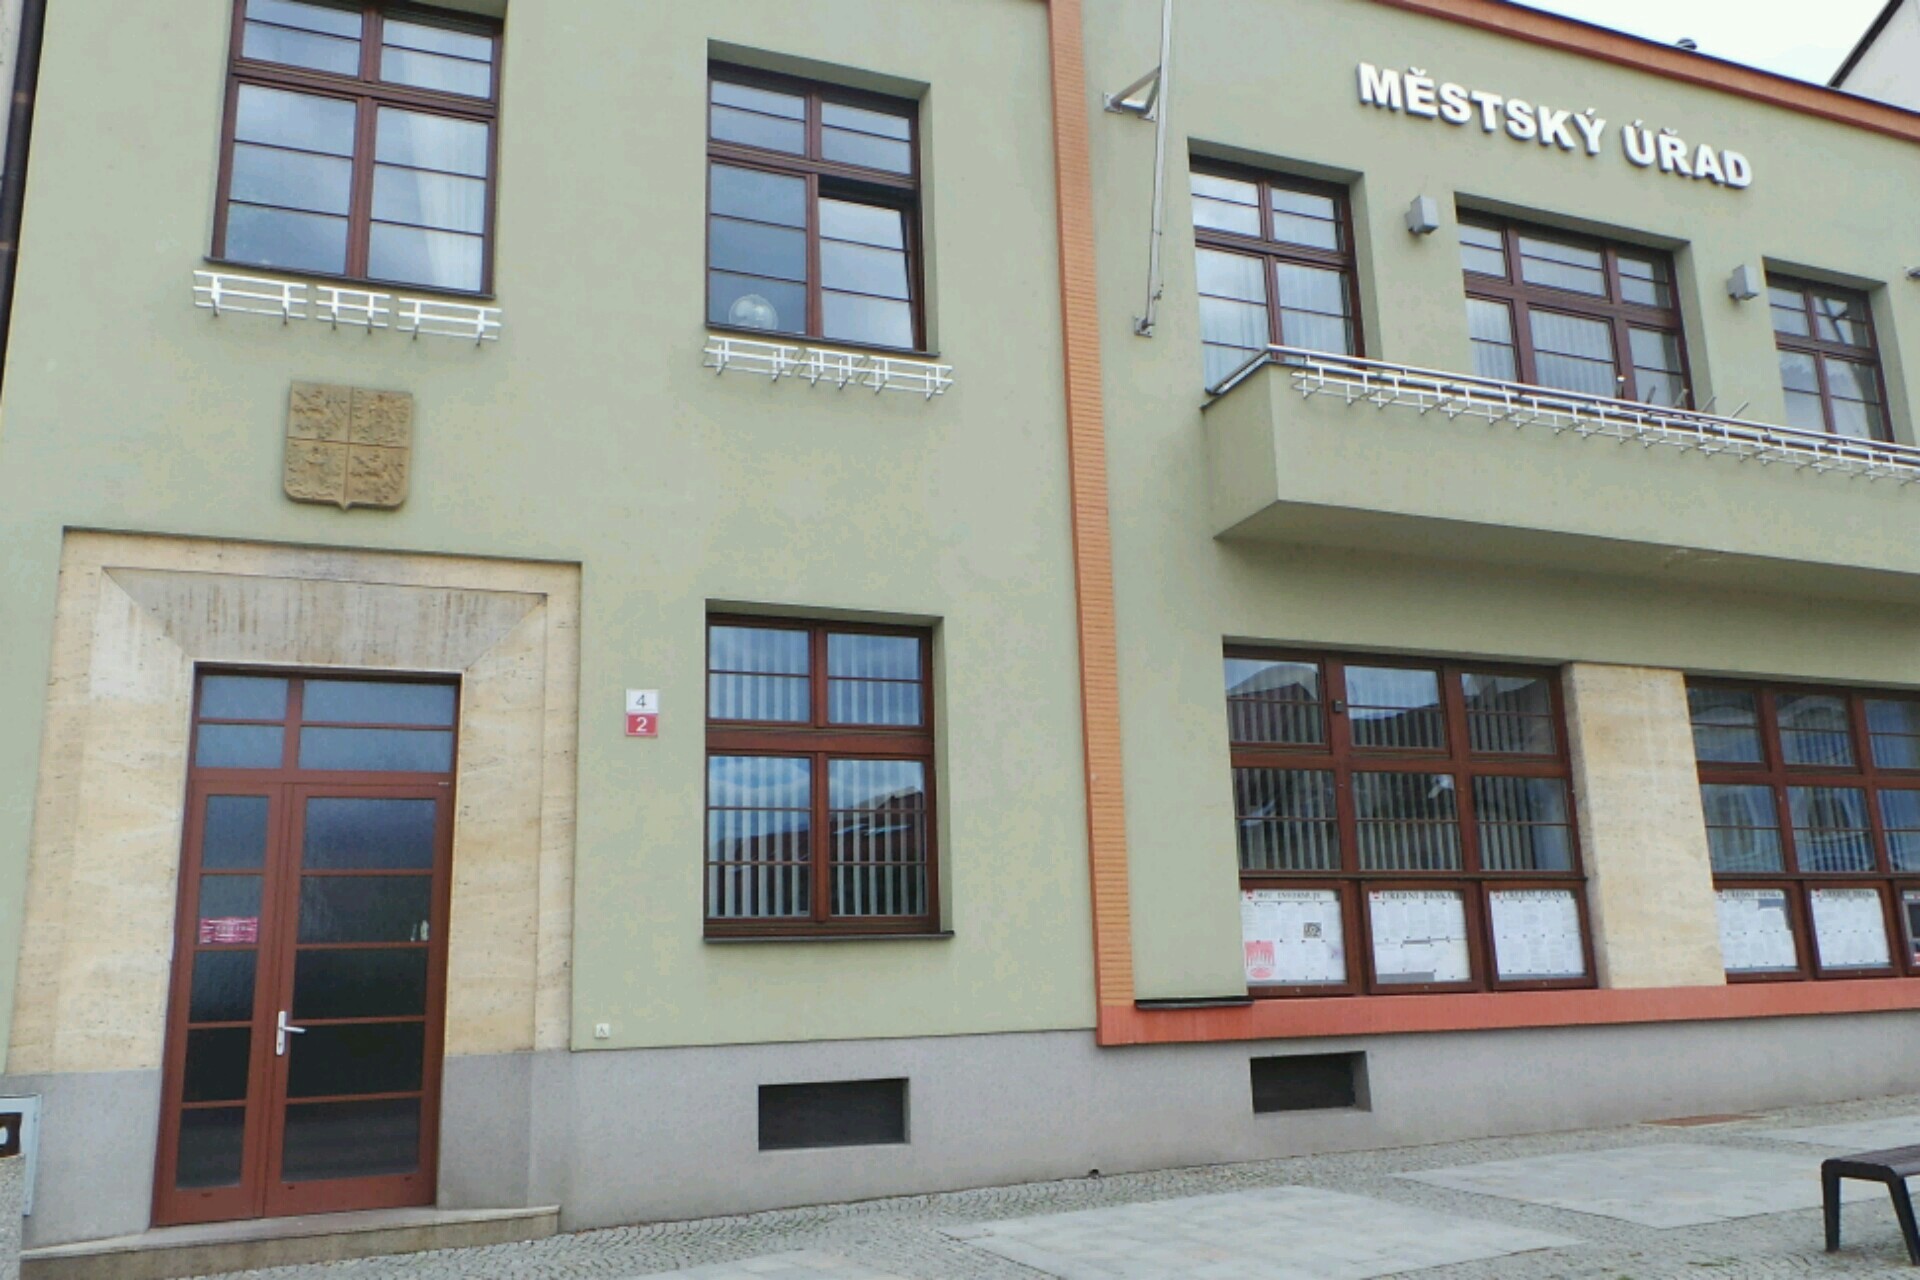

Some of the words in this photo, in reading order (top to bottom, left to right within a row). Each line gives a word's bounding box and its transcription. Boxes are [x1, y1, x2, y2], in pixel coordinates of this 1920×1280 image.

[1357, 62, 1606, 155] MĚSTSKÝ
[1622, 119, 1752, 189] ÚŘAD
[636, 694, 647, 708] 4
[636, 716, 648, 732] 2
